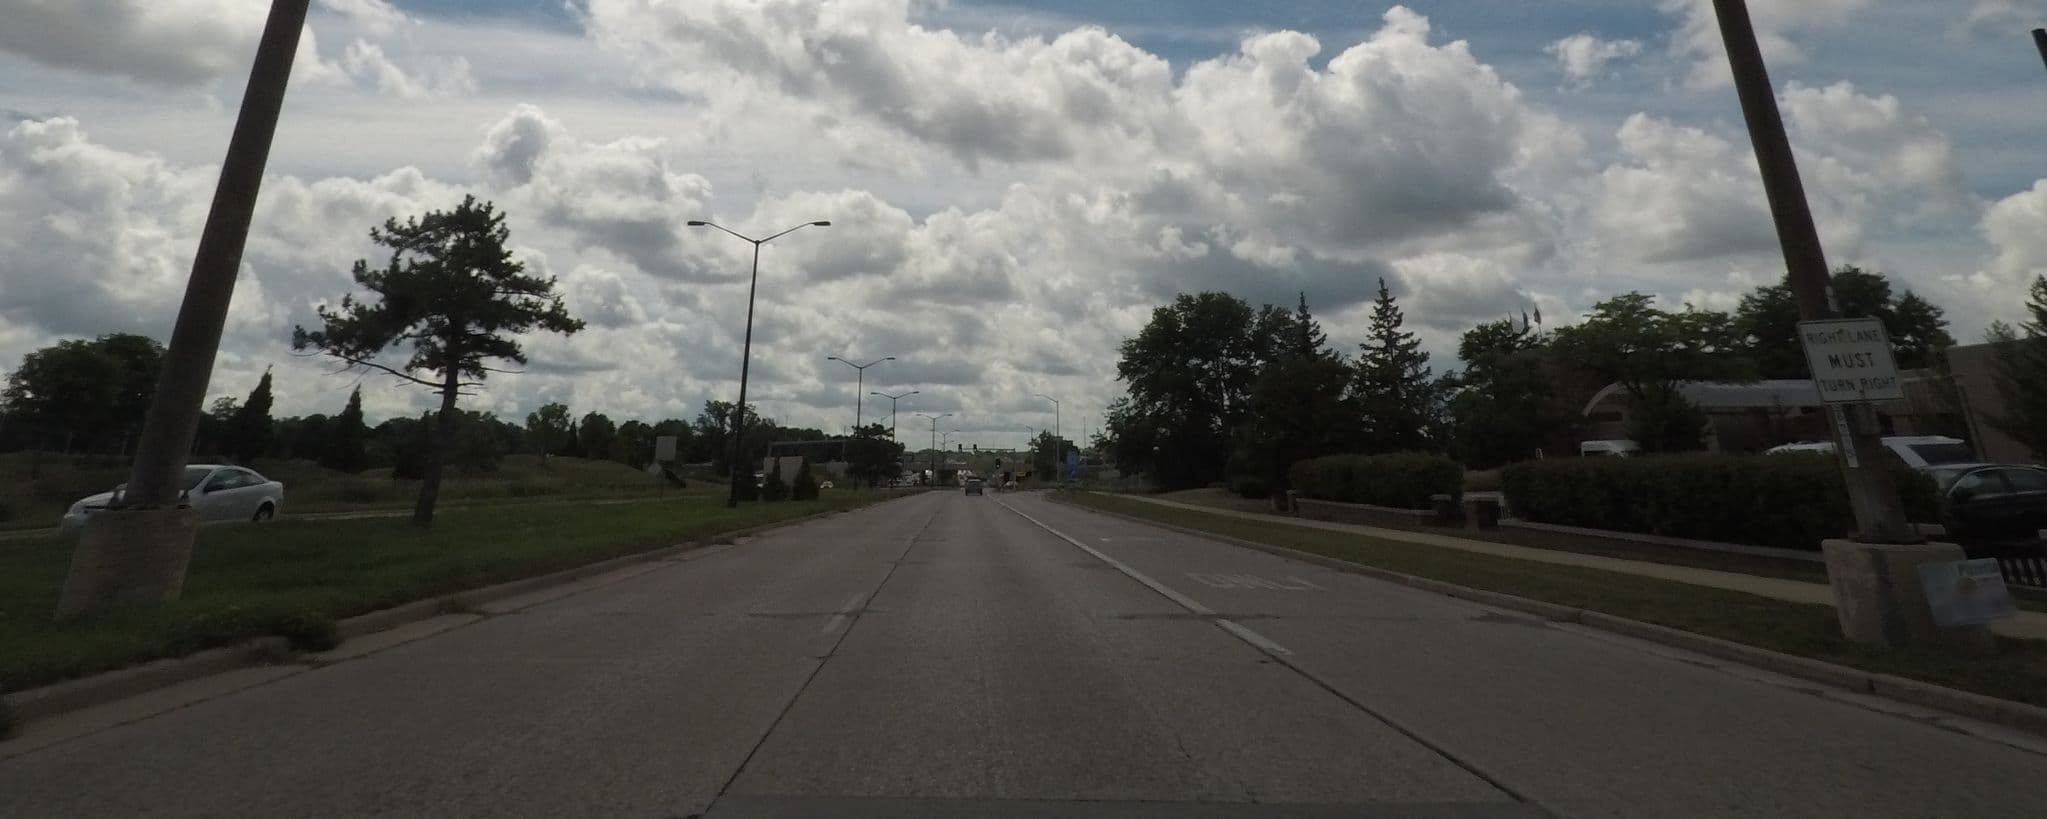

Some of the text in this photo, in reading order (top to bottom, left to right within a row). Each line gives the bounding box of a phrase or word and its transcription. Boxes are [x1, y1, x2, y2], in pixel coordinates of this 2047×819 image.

[1807, 328, 1881, 345] RIGHT LANE
[1828, 352, 1873, 368] MUST
[1820, 376, 1896, 392] TURN RIGHT
